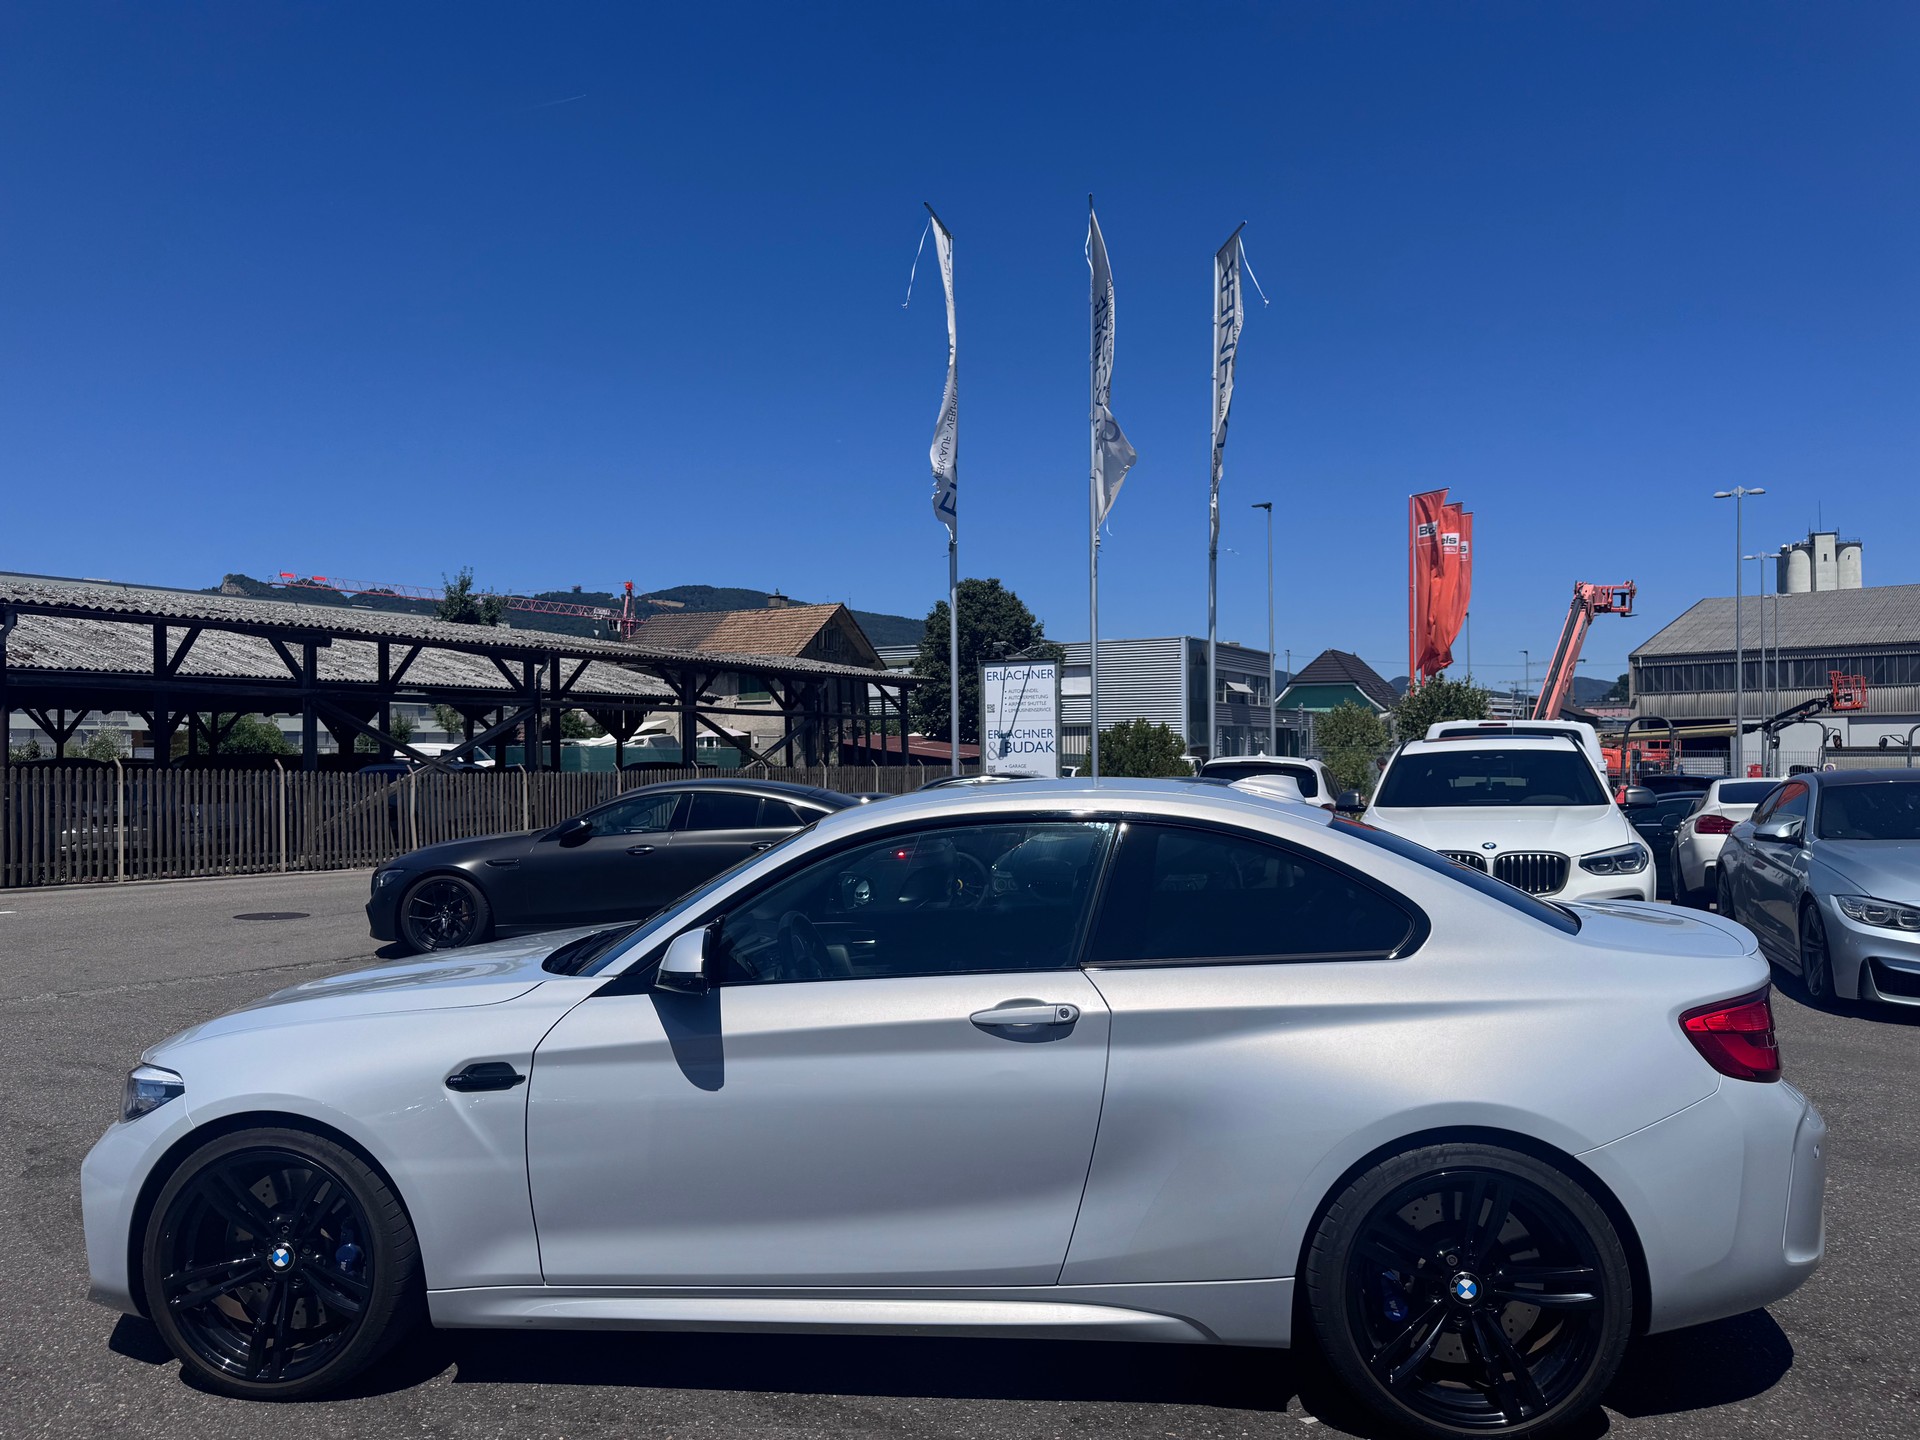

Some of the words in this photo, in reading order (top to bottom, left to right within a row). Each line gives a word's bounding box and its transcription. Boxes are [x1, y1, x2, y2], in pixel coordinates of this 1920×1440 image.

[986, 669, 1055, 681] ERLACHNER
[987, 728, 1055, 740] ERLACHNER
[986, 741, 1005, 761] &
[1004, 740, 1056, 754] BUDAK
